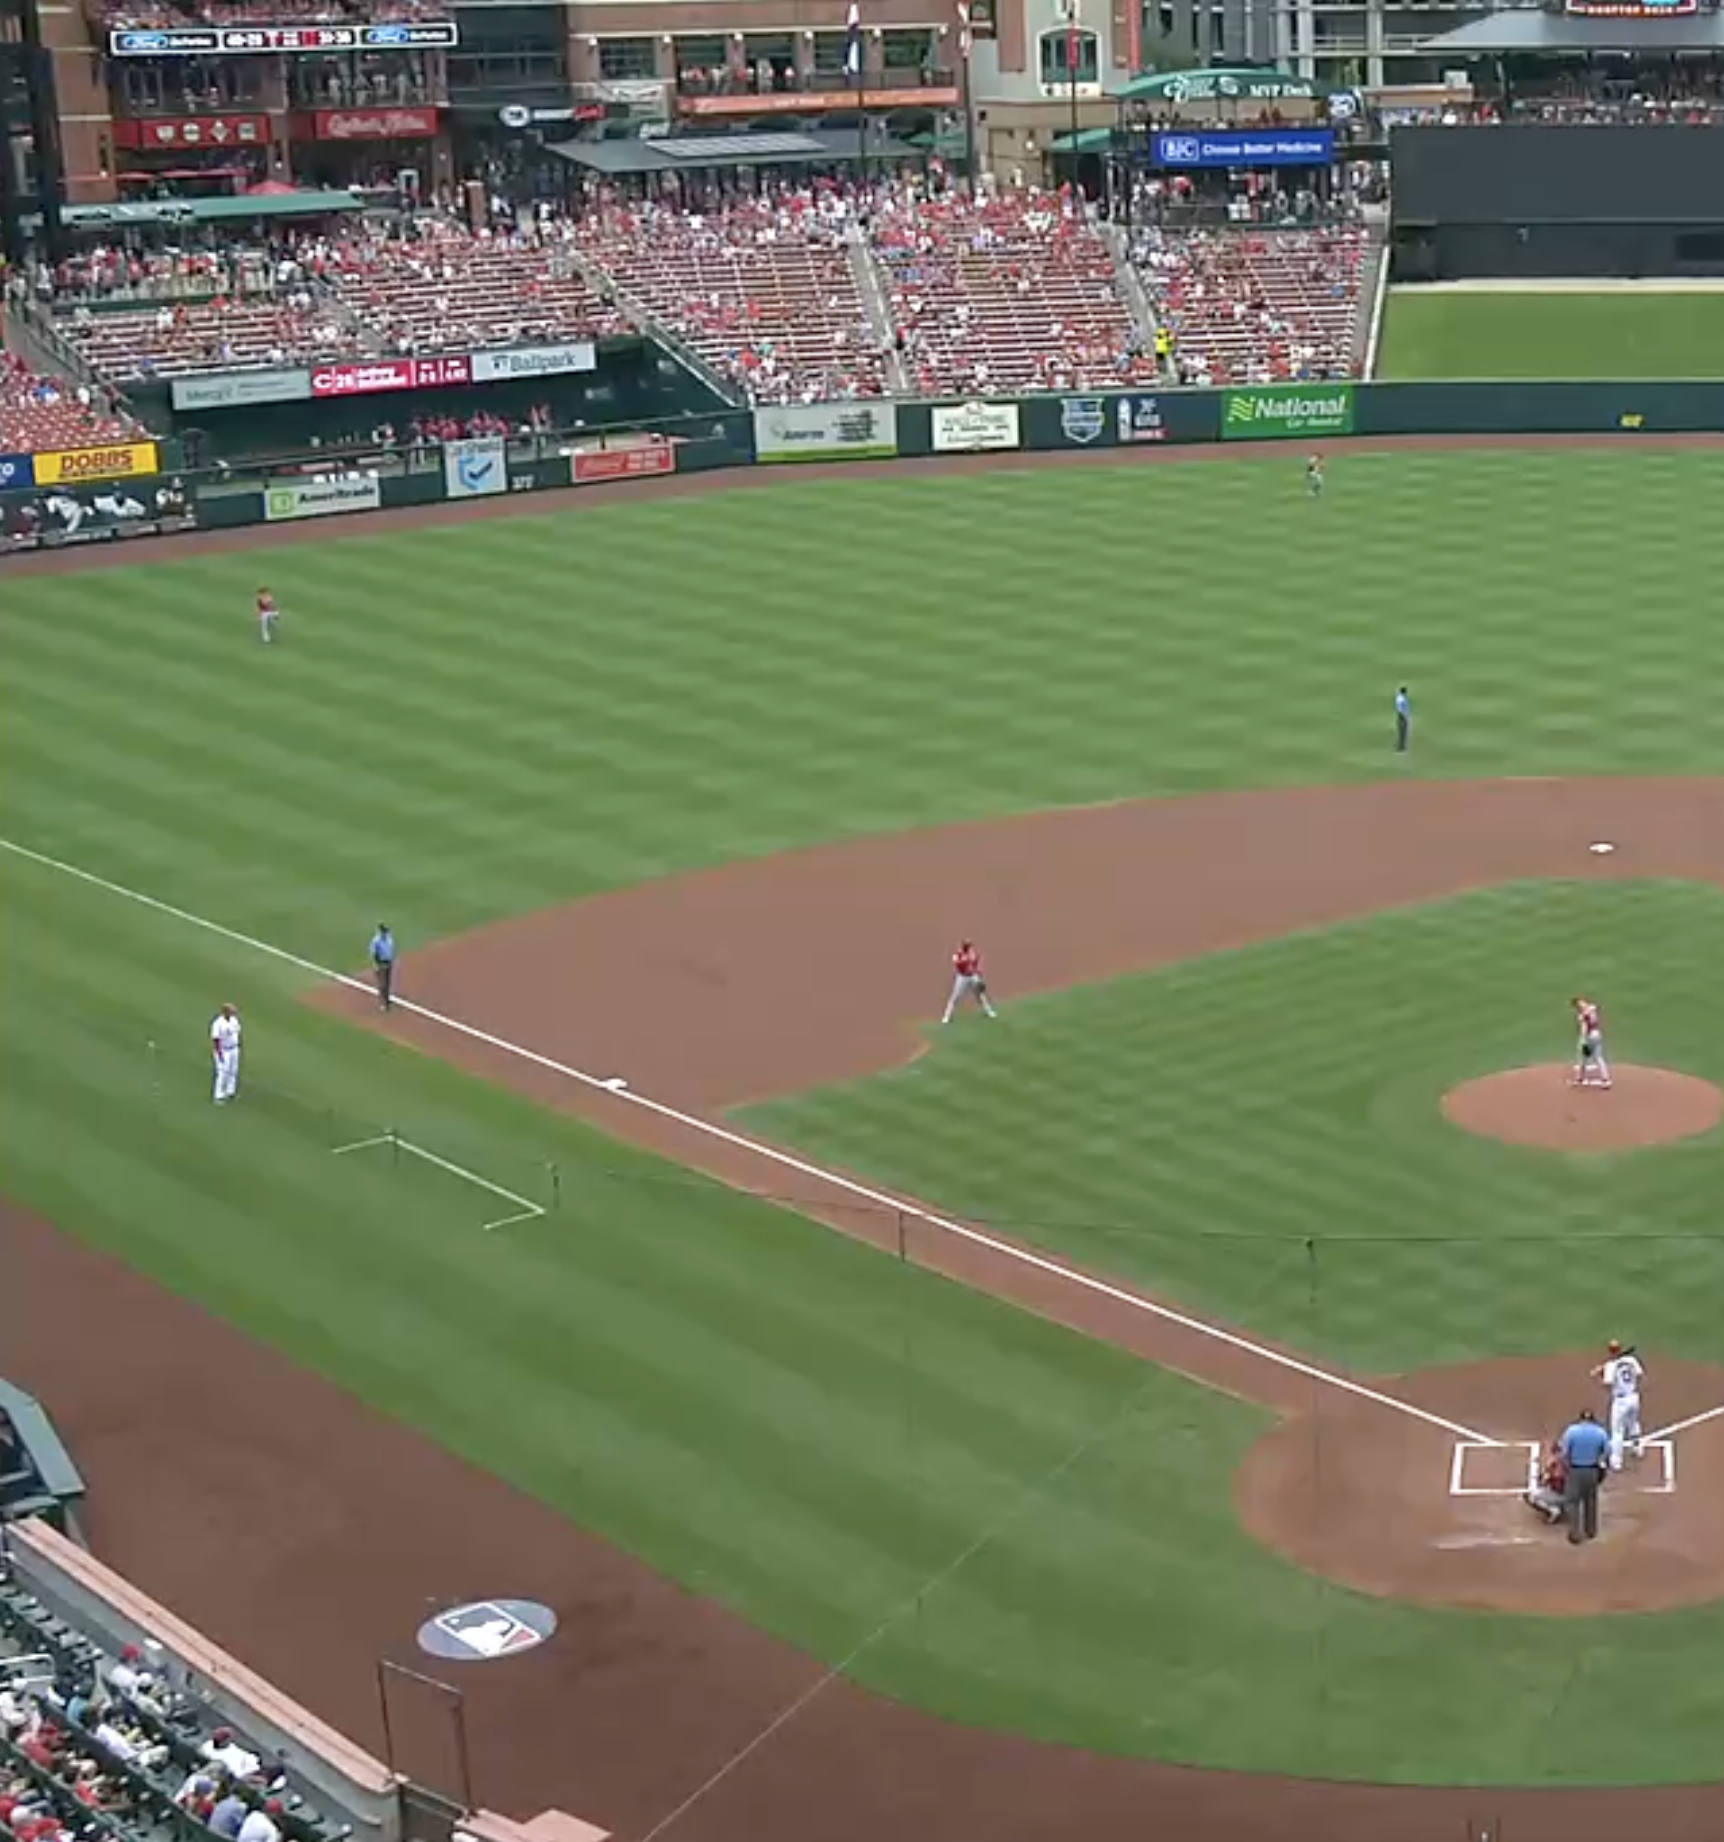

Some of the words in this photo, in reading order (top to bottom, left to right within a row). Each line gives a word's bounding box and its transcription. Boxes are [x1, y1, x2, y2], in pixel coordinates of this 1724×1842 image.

[510, 352, 576, 371] Ballpark
[1255, 396, 1346, 418] National
[61, 450, 133, 471] DOBBS
[299, 485, 375, 503] Ameritrade
